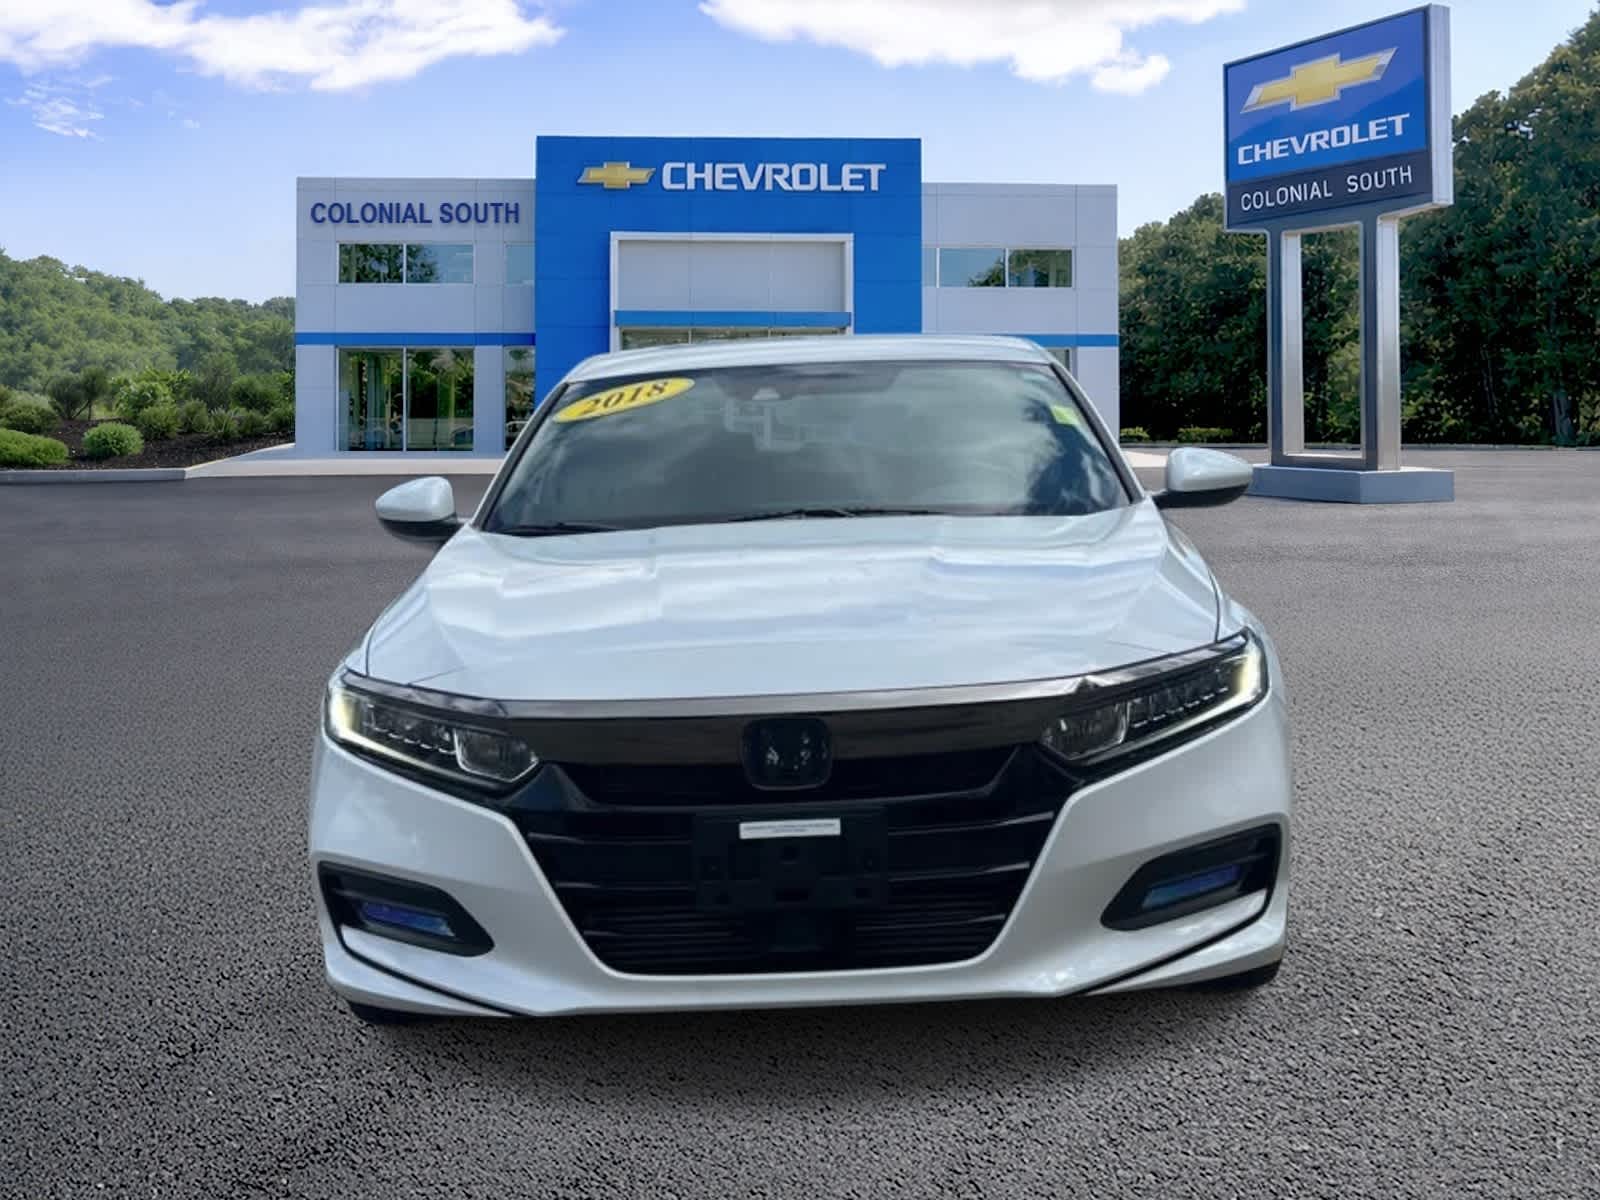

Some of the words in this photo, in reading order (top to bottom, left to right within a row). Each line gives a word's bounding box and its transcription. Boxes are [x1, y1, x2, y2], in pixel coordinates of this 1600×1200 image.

[1237, 113, 1410, 165] CHEVROLET
[661, 162, 887, 192] CHEVROLET
[1241, 180, 1333, 211] COLONIAL
[1346, 165, 1412, 194] SOUTH
[310, 202, 433, 224] COLONIAL
[439, 202, 520, 224] SOUTH
[581, 381, 669, 415] 2018
